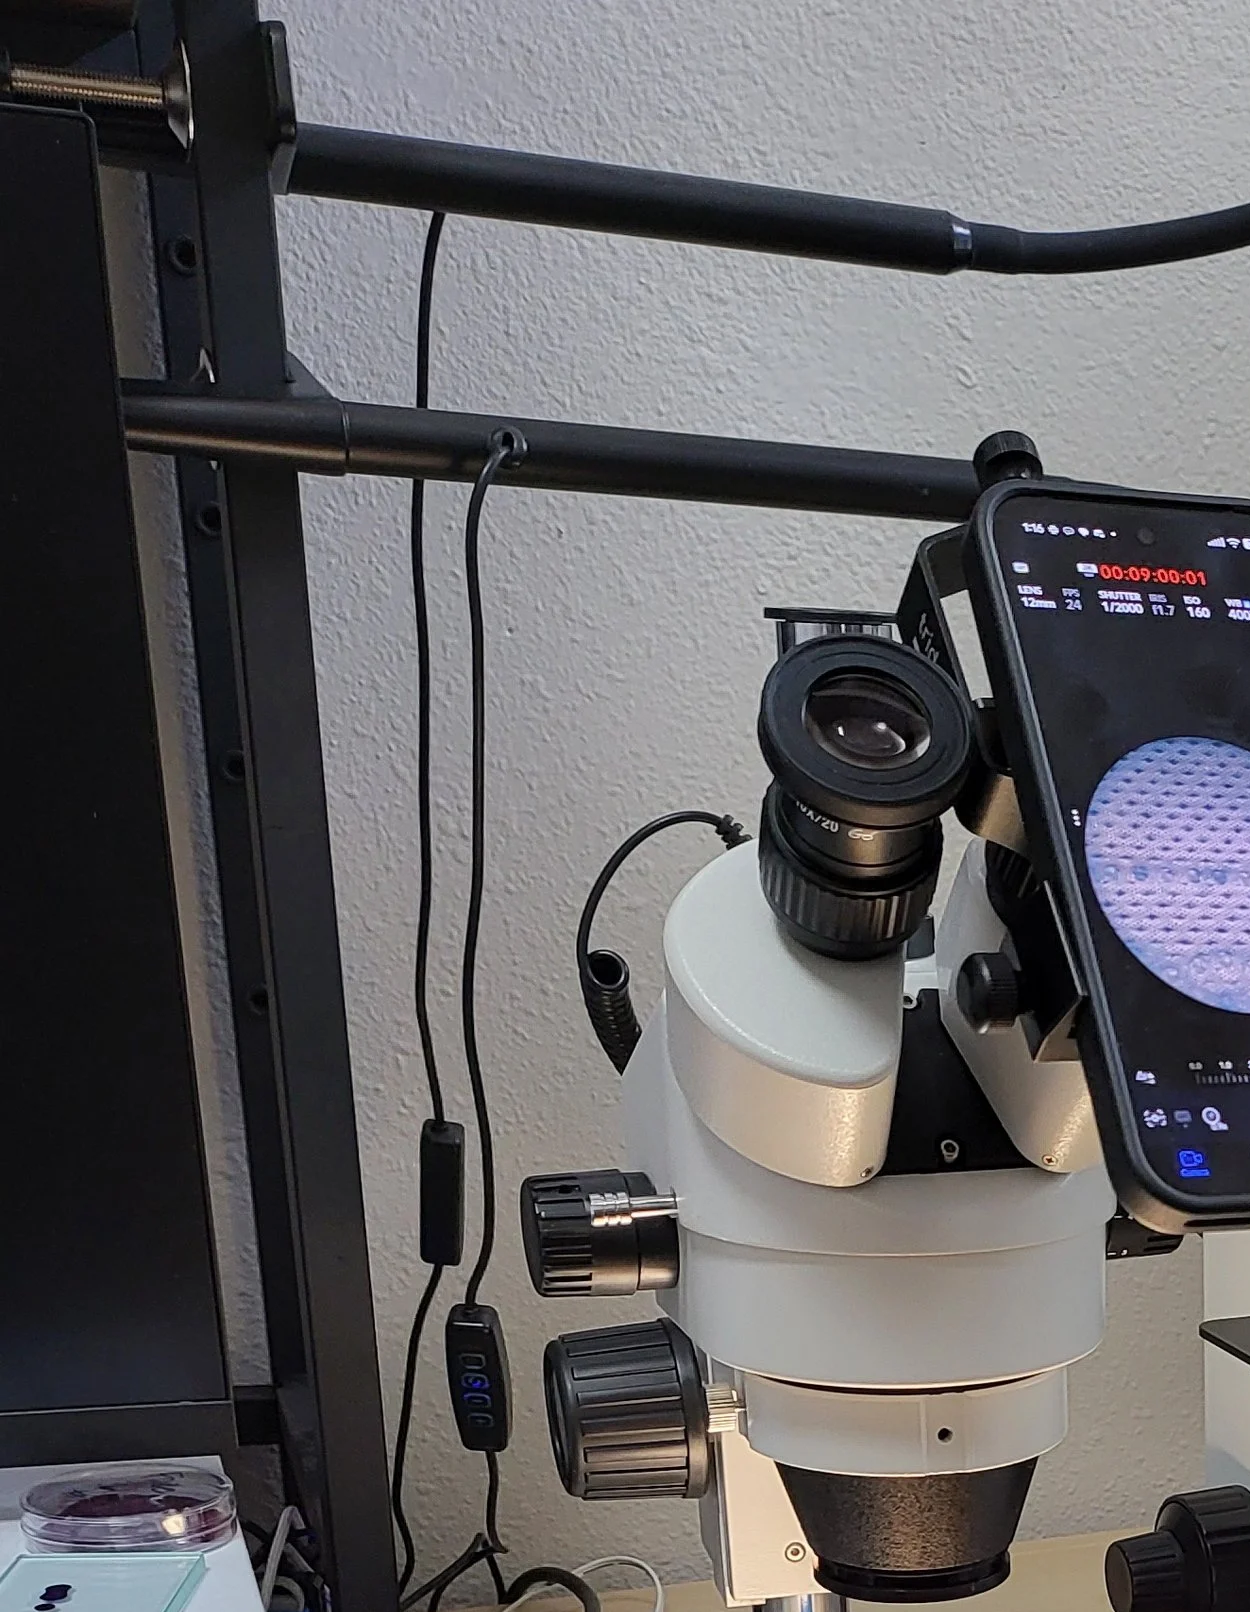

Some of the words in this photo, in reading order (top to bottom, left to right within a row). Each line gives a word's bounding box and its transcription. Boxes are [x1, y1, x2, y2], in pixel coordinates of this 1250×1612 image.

[1100, 563, 1207, 587] 00:09:00:01
[1017, 585, 1043, 596] LENS
[1062, 588, 1080, 598] FPS
[1098, 590, 1143, 602] SHUTTER
[1183, 595, 1201, 605] ISO
[1020, 597, 1057, 610] 12mm
[1065, 599, 1083, 611] 24
[1101, 601, 1144, 615] 1/2000
[1186, 606, 1211, 619] 160
